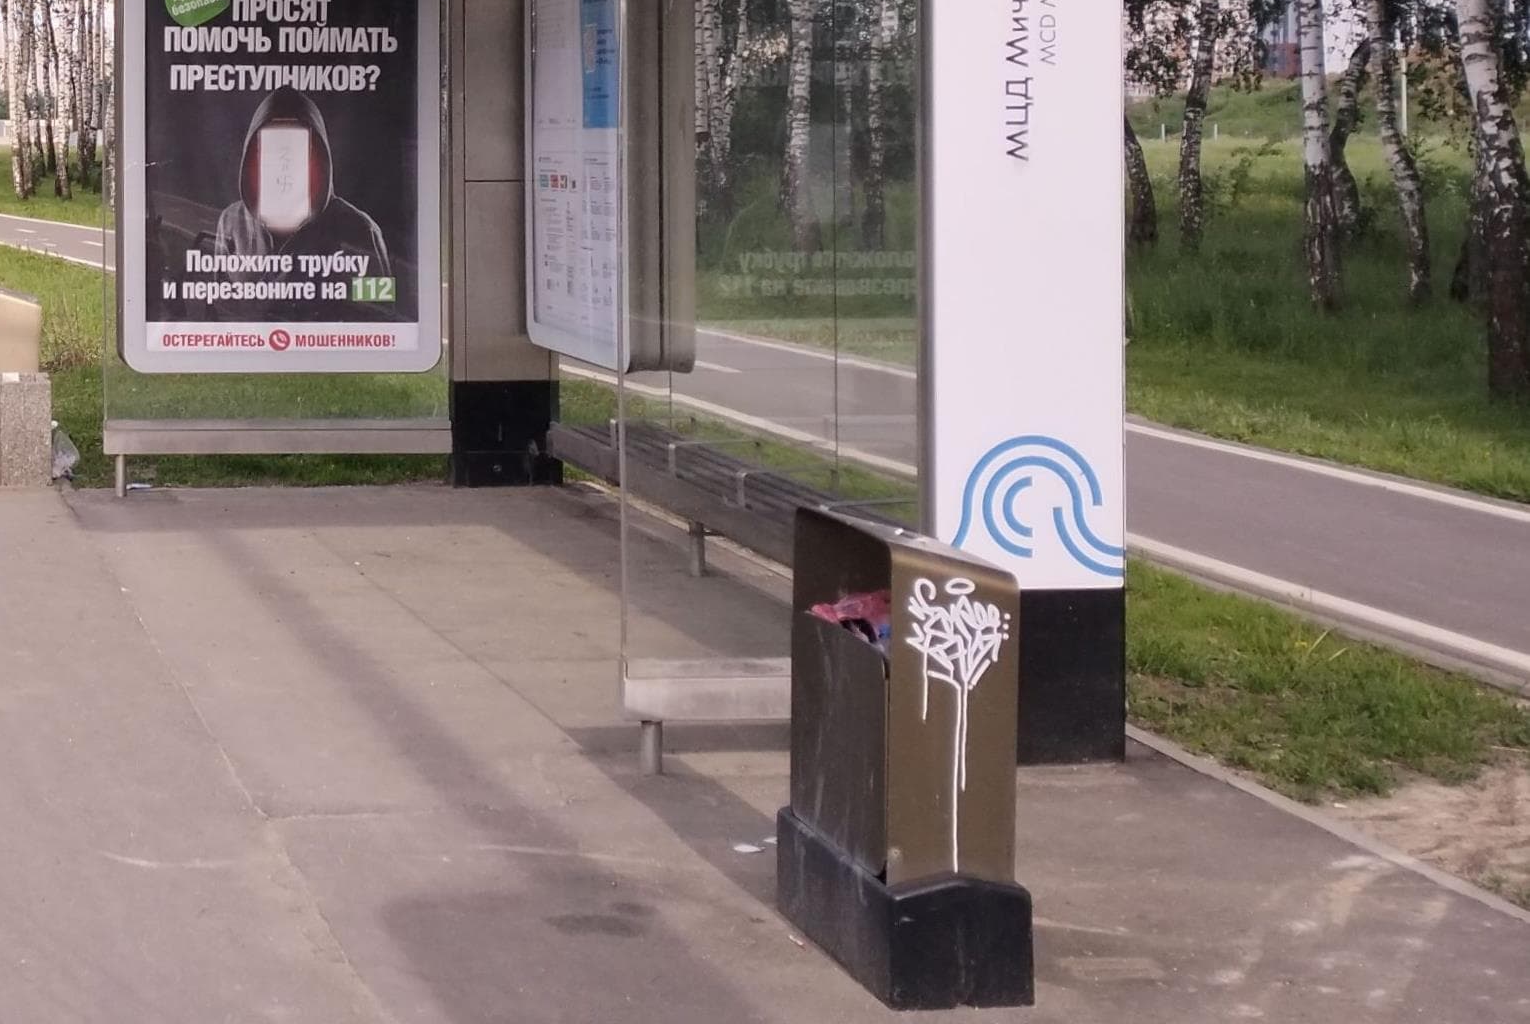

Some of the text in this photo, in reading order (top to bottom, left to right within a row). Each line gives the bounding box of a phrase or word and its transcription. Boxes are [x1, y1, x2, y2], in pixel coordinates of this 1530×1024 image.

[164, 20, 398, 53] ПОМОЧЬ ПОЙМАТЬ
[1039, 14, 1056, 65] MCD
[170, 64, 381, 92] ПРЕСТУПНИКОВ?
[1006, 77, 1033, 161] МЦД
[186, 250, 370, 277] Положите трубку
[163, 277, 393, 304] и перезвоните на 112
[162, 332, 396, 348] ОСТЕРЕГАЙТЕСЬ МОШЕННИКОВ!
